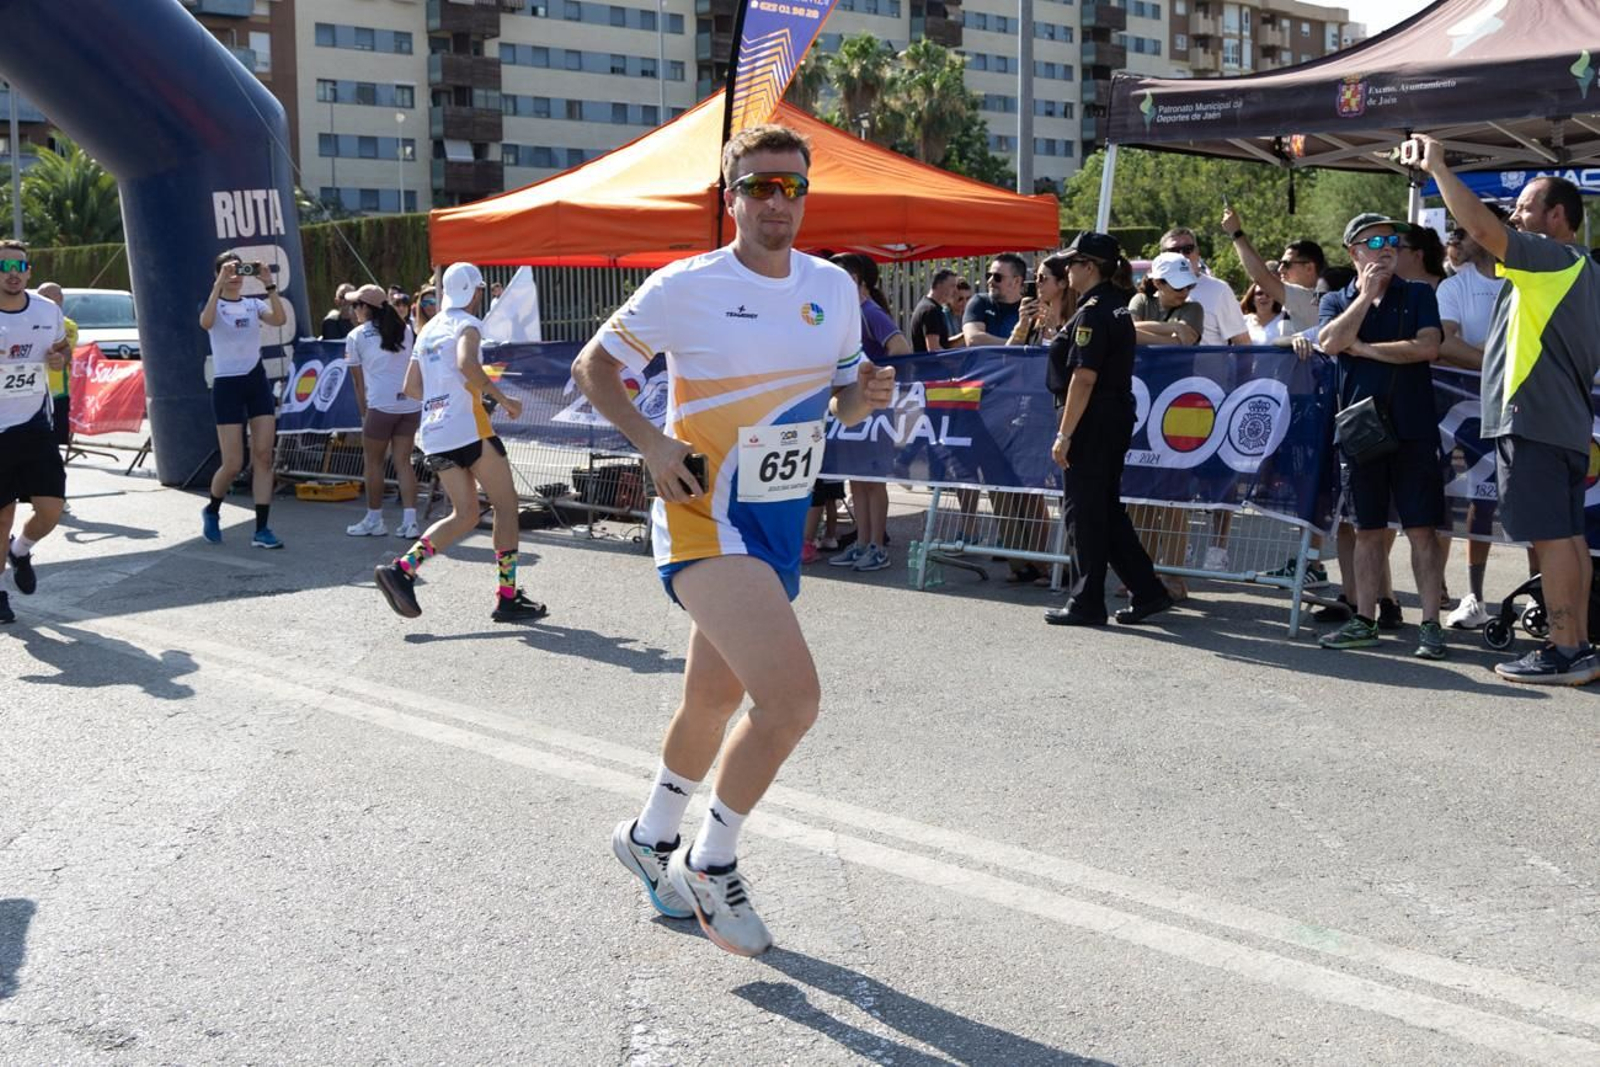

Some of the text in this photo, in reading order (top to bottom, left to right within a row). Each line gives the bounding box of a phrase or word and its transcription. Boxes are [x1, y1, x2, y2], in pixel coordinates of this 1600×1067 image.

[1400, 80, 1457, 92] Ayuntamiento
[1158, 104, 1193, 114] Patronato
[1195, 101, 1231, 111] Municipal
[1366, 98, 1376, 106] de
[1156, 114, 1190, 123] Deportes
[1191, 113, 1201, 121] de
[212, 189, 285, 239] RUTA
[4, 372, 36, 389] 254
[826, 413, 972, 446] IONAL
[759, 446, 813, 483] 651
